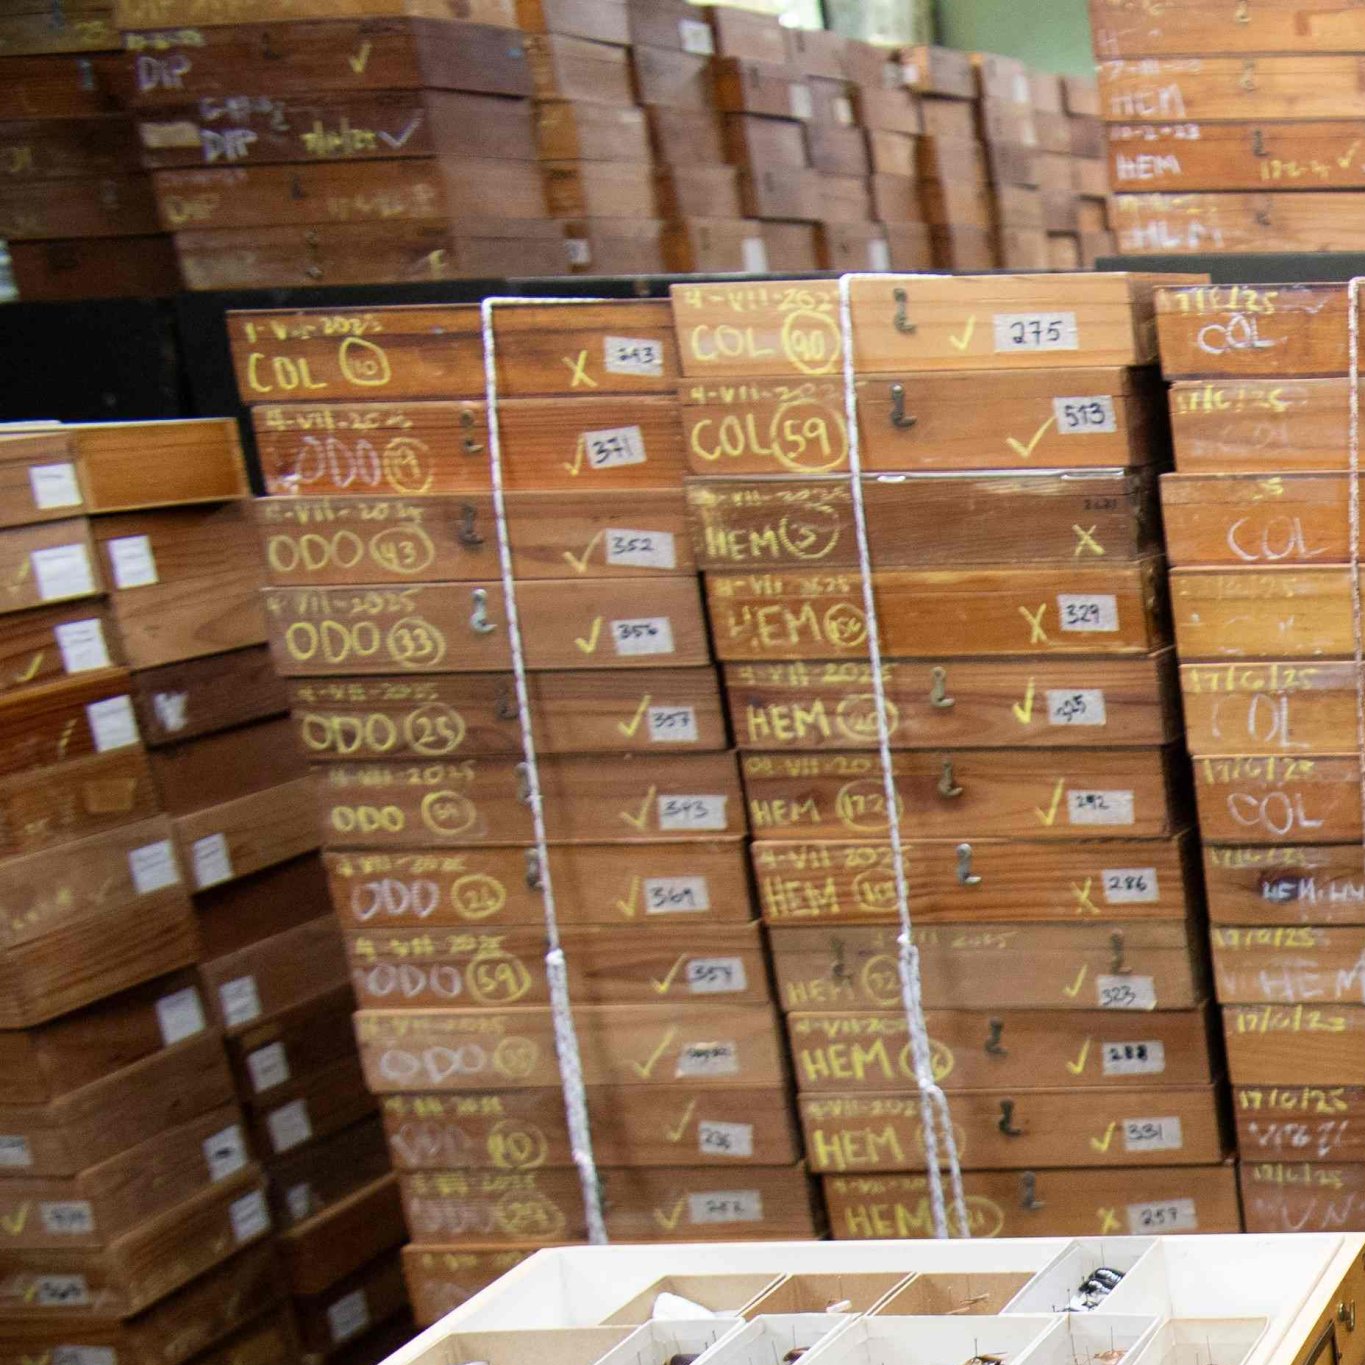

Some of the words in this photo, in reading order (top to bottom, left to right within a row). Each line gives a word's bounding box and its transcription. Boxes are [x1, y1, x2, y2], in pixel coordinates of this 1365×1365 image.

[136, 53, 193, 93] DIP
[691, 324, 775, 359] COL
[1009, 320, 1063, 345] 275
[1198, 311, 1278, 354] COL
[247, 351, 327, 393] COL
[690, 412, 777, 462] COL
[268, 530, 364, 572] ODO
[610, 535, 656, 554] 352
[705, 525, 780, 561] HEM
[1226, 515, 1326, 562] COL
[285, 621, 381, 663] ODO
[302, 713, 397, 754] ODO
[747, 699, 830, 743] HEM
[331, 805, 404, 832] ODO
[751, 798, 821, 828] HEM
[1227, 790, 1324, 836] COL
[379, 1042, 486, 1085] ODO
[800, 1040, 894, 1081] HEM
[812, 1125, 902, 1170] HEM
[844, 1202, 932, 1238] HEM
